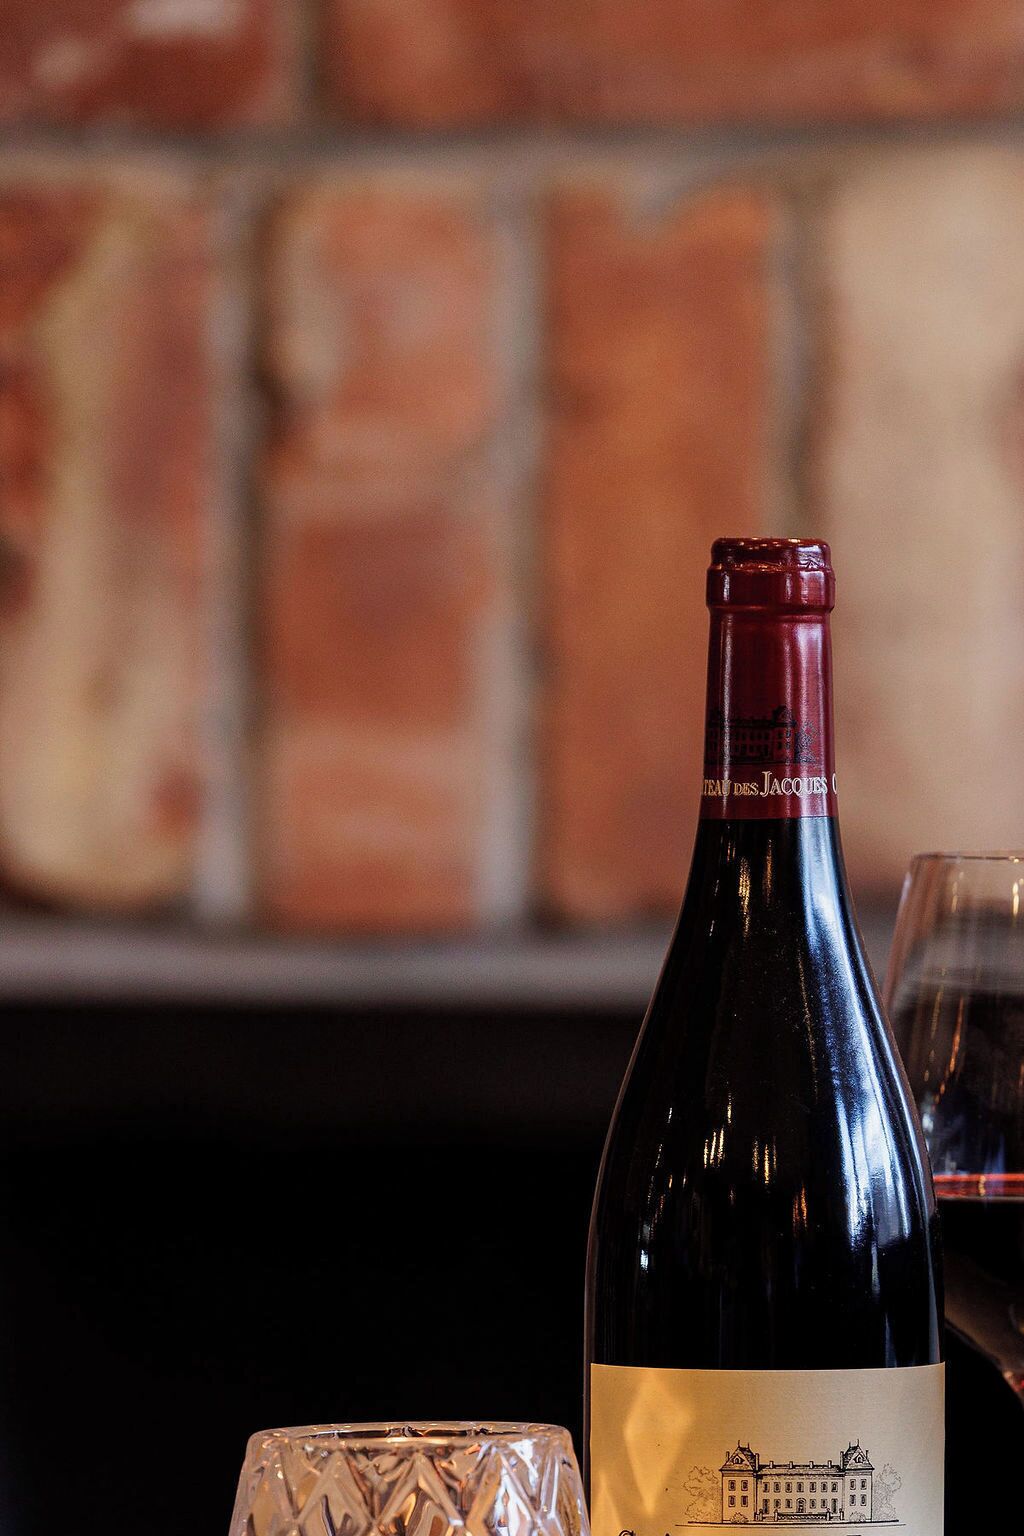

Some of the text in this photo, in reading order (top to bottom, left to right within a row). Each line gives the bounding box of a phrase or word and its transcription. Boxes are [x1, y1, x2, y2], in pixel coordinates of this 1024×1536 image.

[702, 779, 731, 796] TEAU
[734, 782, 759, 796] DES
[760, 770, 828, 798] JACQUES
